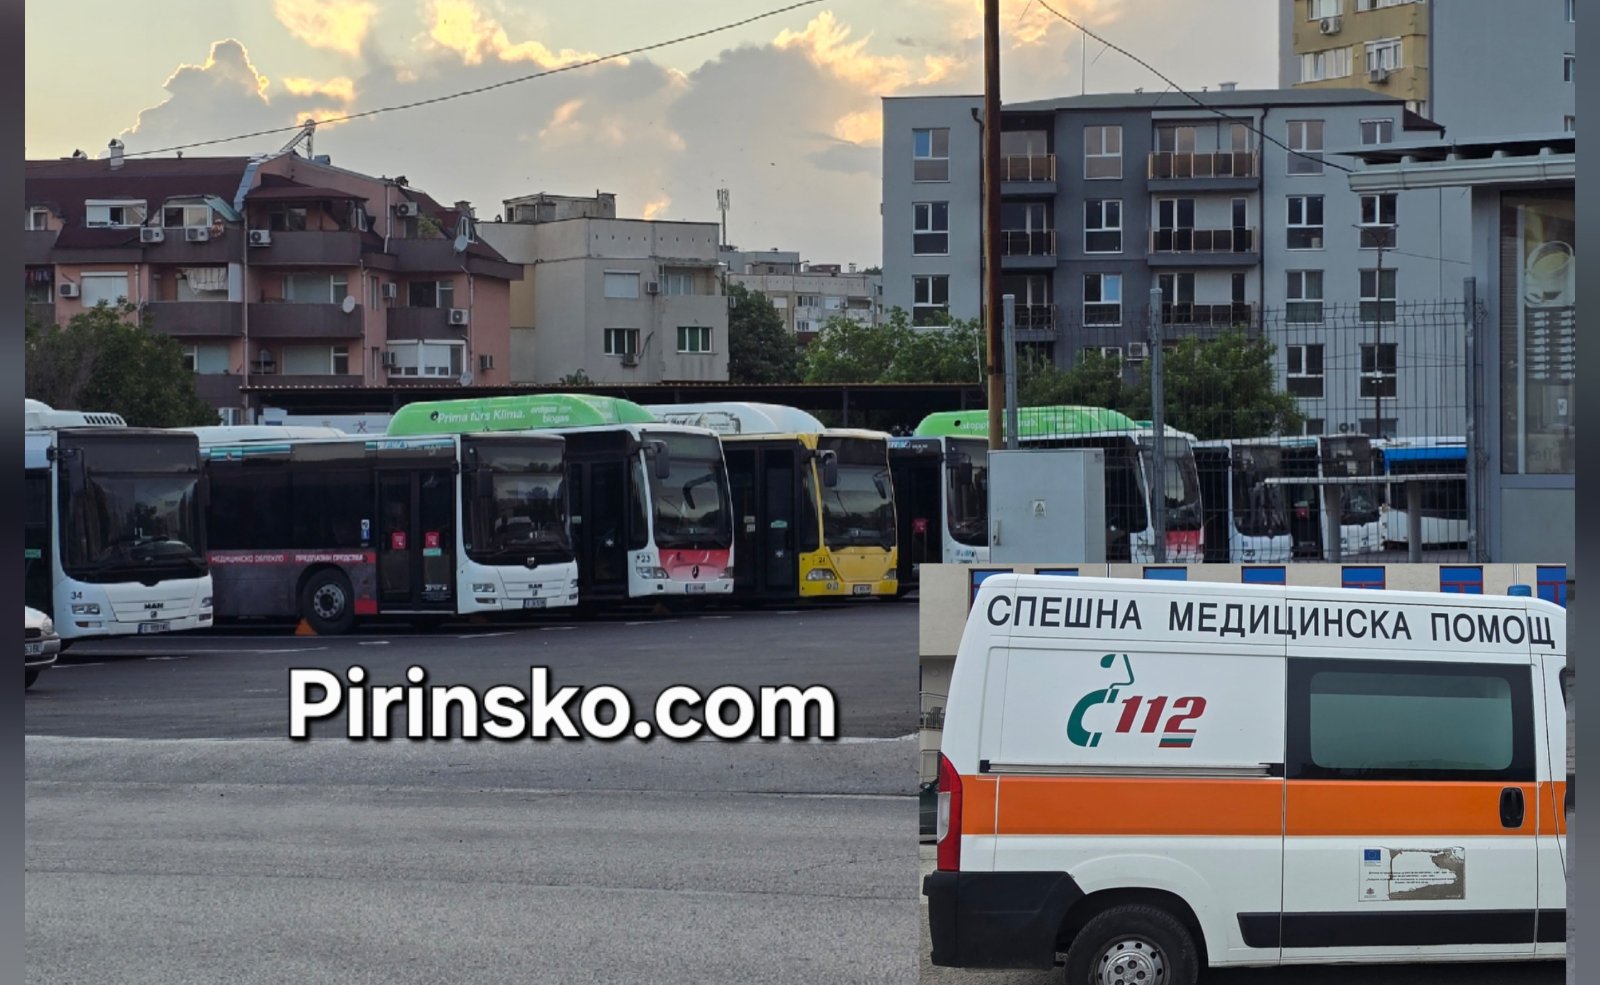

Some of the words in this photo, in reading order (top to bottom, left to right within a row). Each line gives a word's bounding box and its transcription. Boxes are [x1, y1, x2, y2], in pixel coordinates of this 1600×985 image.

[437, 413, 467, 424] Prima
[470, 410, 490, 422] fürs
[494, 409, 525, 420] Klima.
[71, 591, 83, 600] 34
[987, 594, 1142, 630] СПЕШНА
[1168, 600, 1412, 642] МЕДИЦИНСКА
[1430, 612, 1556, 649] ПОМОЩ
[1115, 695, 1207, 734] 112
